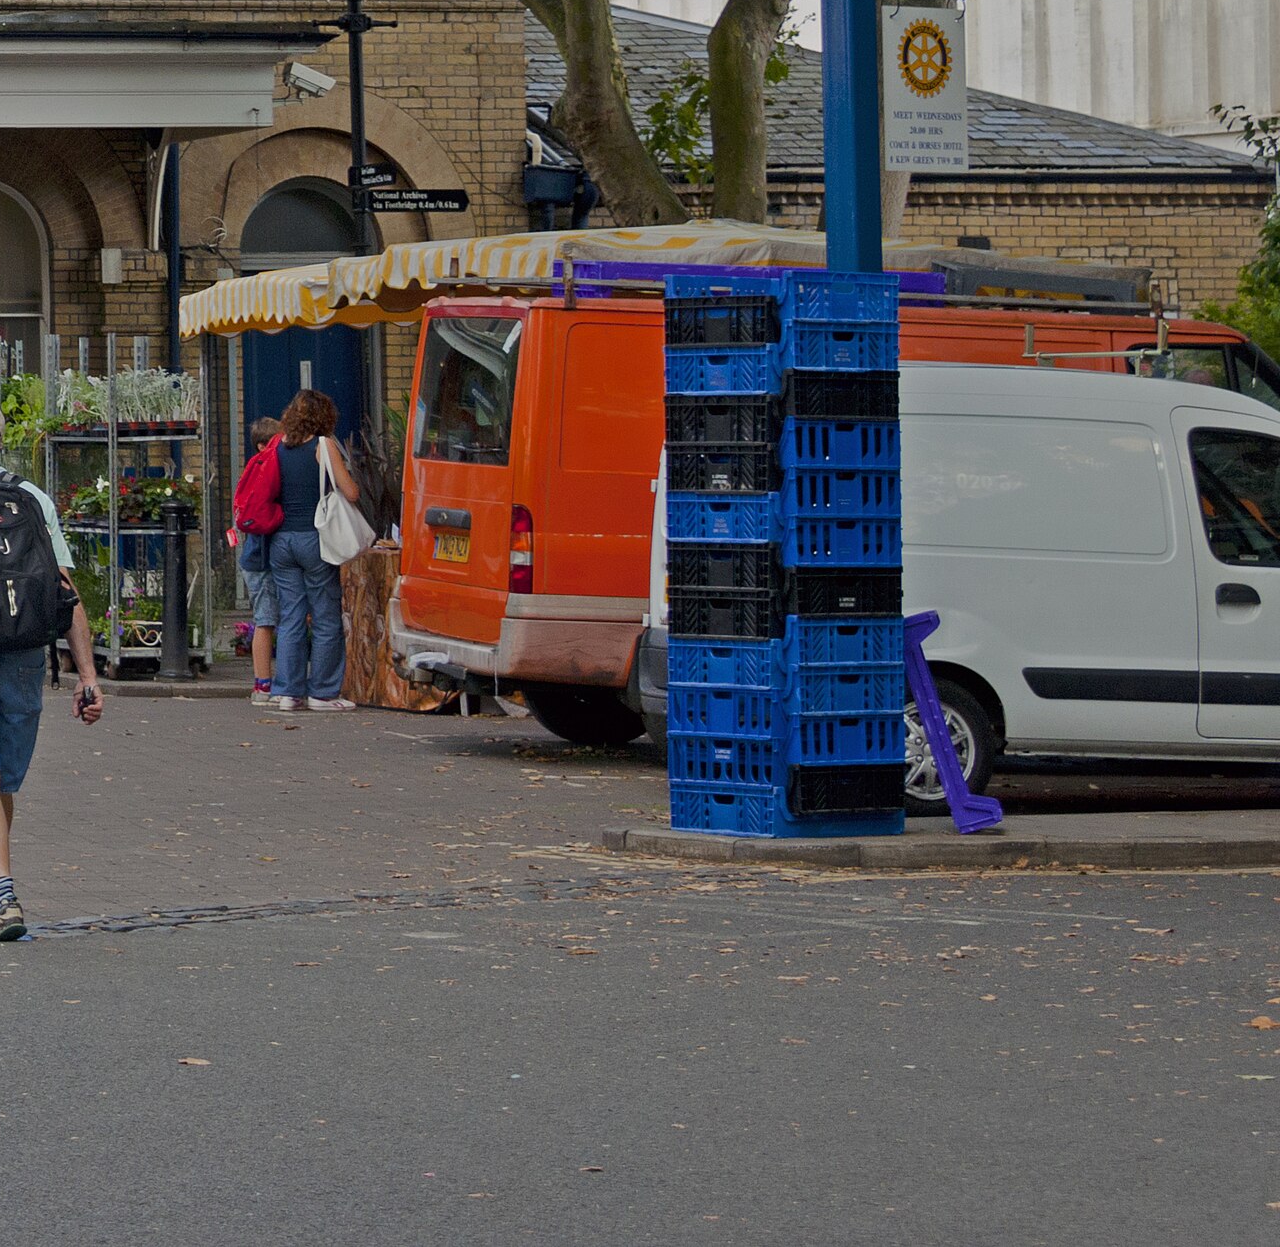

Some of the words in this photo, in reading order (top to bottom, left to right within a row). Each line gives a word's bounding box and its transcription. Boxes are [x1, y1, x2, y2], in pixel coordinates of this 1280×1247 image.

[893, 111, 913, 120] MEET
[916, 112, 962, 121] WEDNESDAYS
[928, 127, 943, 135] HRS
[889, 141, 909, 149] COACH
[895, 156, 910, 164] KEW
[913, 156, 934, 164] GREEN
[385, 201, 417, 210] Footbridge
